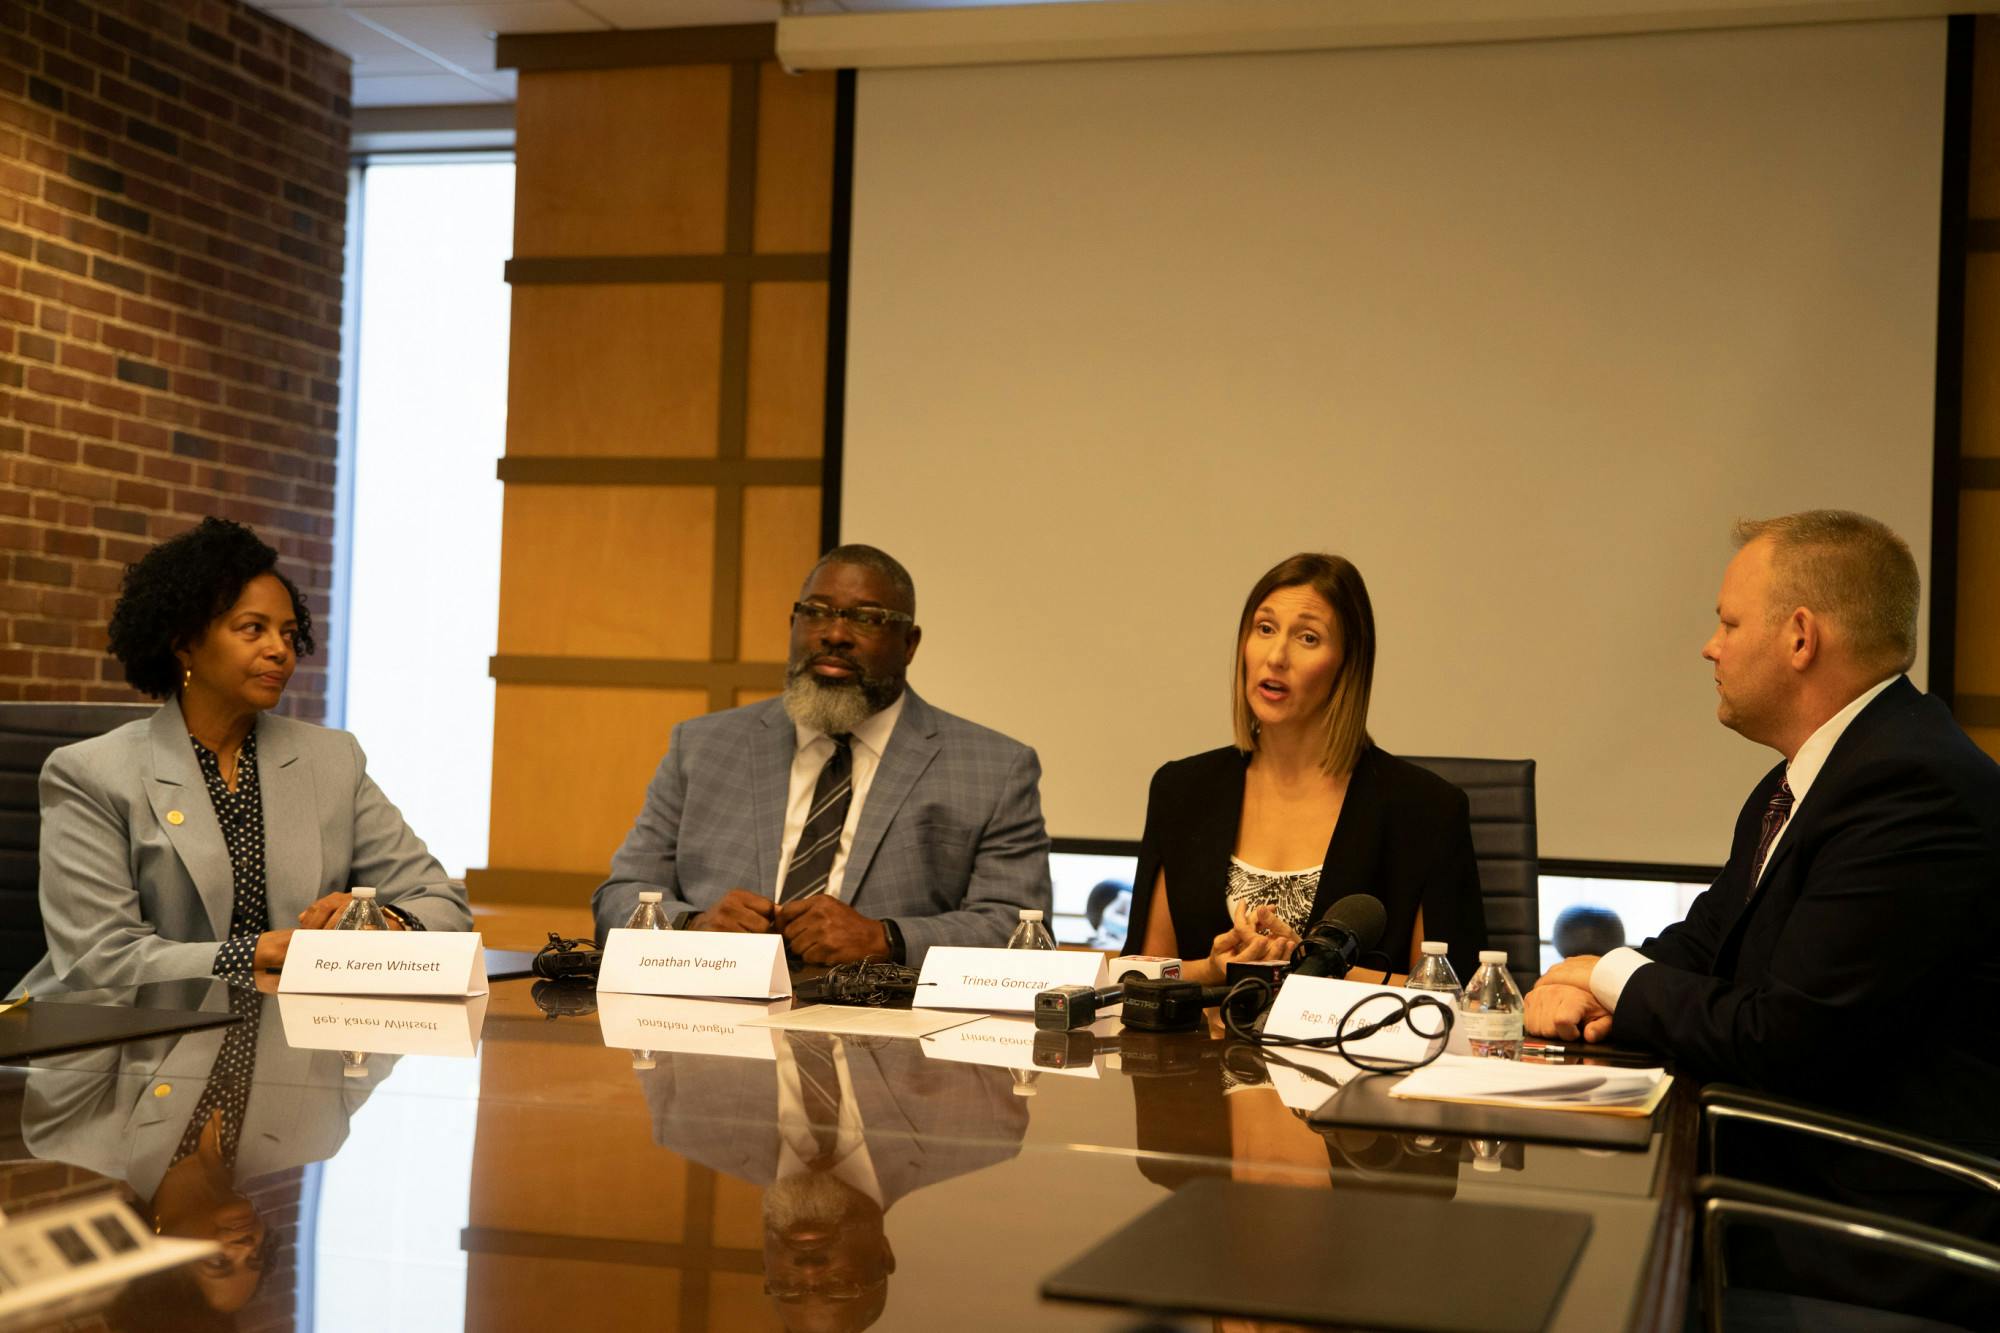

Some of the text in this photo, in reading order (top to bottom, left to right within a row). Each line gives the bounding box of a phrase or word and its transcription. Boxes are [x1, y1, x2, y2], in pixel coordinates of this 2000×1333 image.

[315, 959, 440, 972] Rep. Karen Whitsett
[639, 956, 737, 970] Jonathan Vaughn
[962, 975, 1049, 989] Trinea Gonczar
[1327, 1014, 1355, 1028] Ryn
